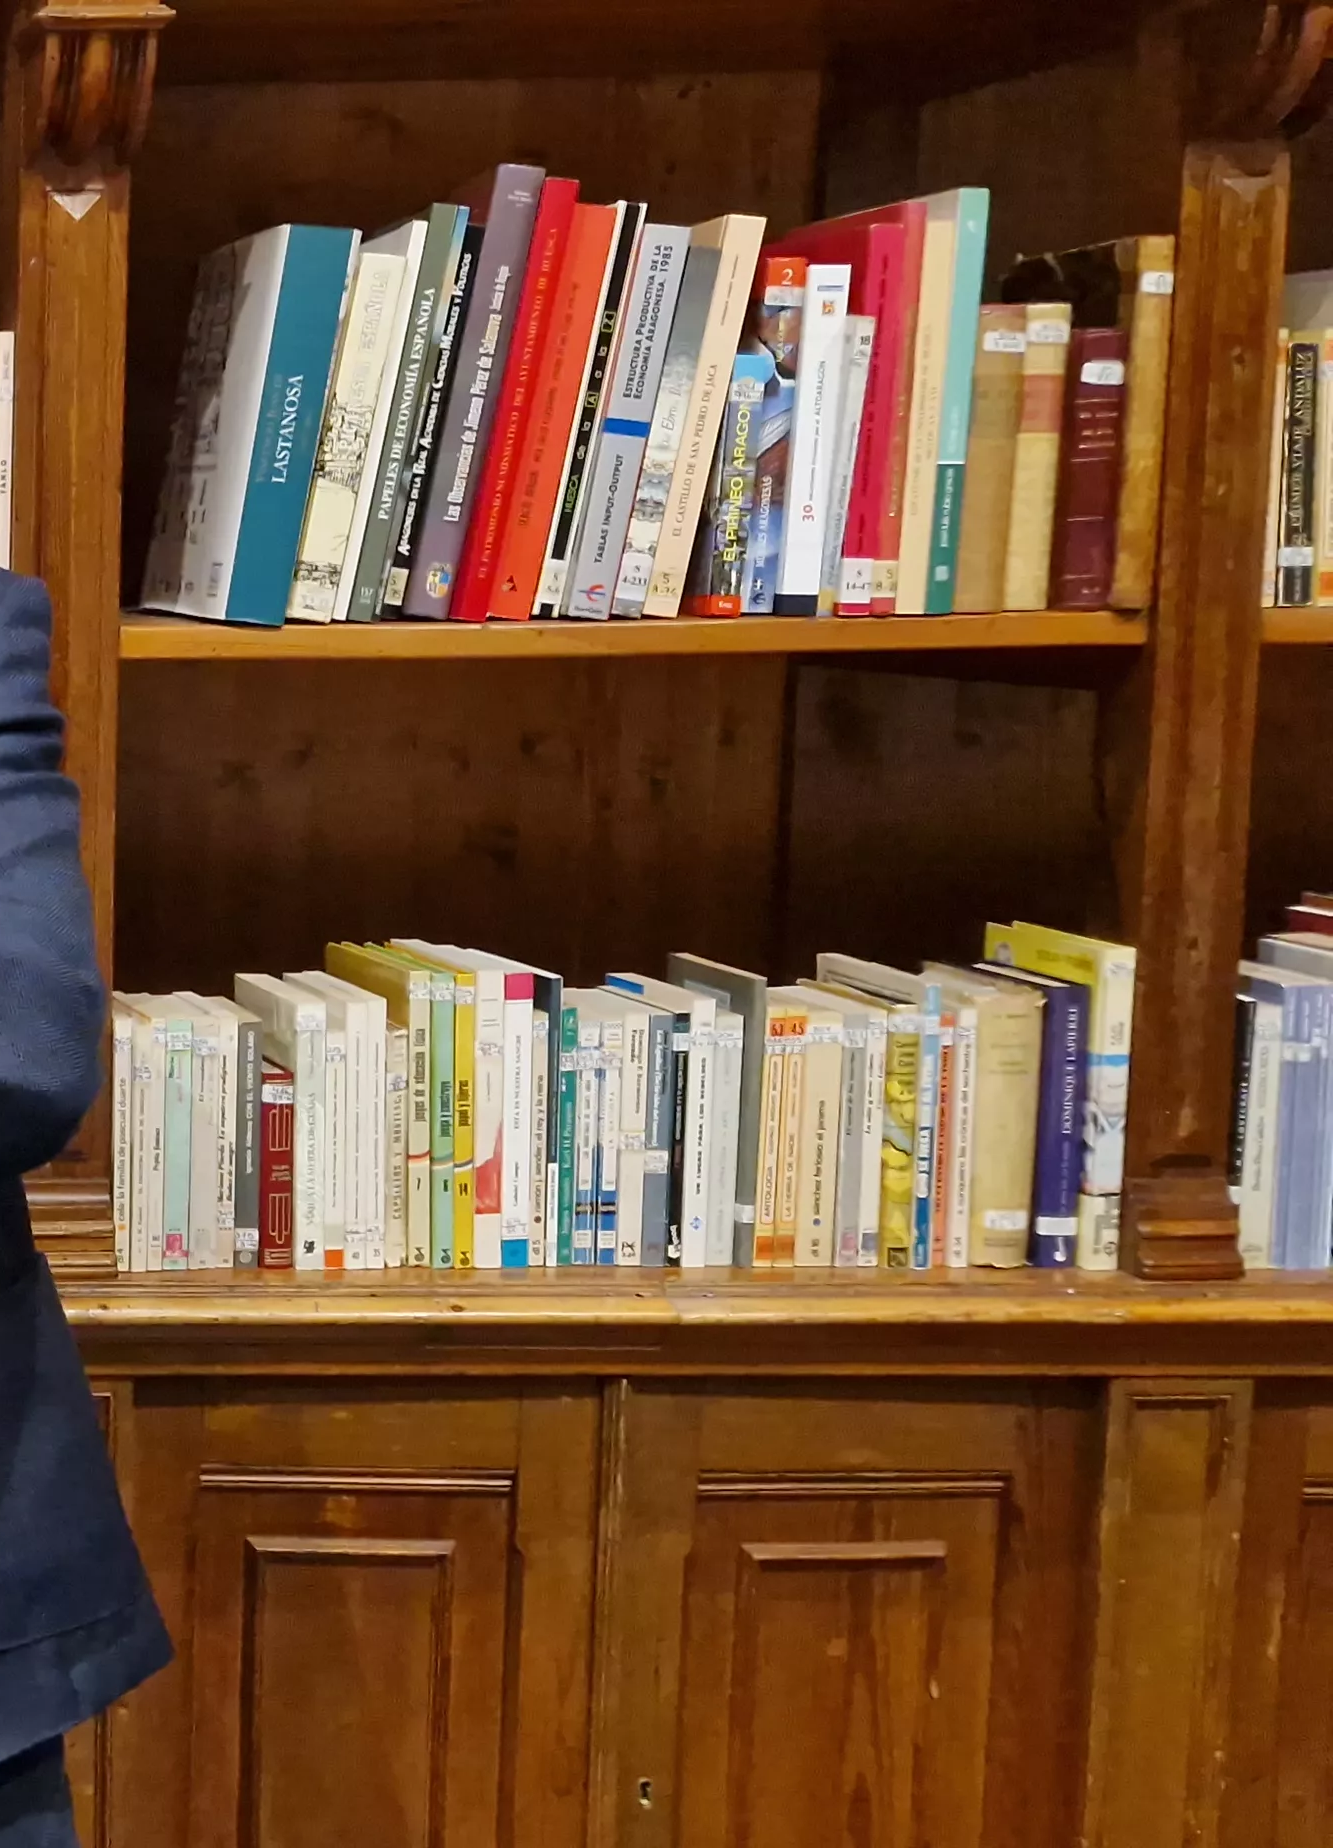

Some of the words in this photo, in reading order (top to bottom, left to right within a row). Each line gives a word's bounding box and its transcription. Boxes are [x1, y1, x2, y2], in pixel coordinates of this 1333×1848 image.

[652, 244, 662, 257] LA
[647, 258, 659, 272] DE
[781, 269, 793, 285] 2
[635, 275, 659, 336] PRODUCTIVA
[411, 288, 435, 360] ESPAÑOLA
[477, 356, 493, 368] de
[598, 345, 608, 356] la
[622, 338, 644, 398] ESTRUCTURA
[705, 364, 719, 388] JACA
[470, 370, 491, 395] Pérez
[395, 362, 421, 437] ECONOMÍA
[587, 394, 597, 404] A
[701, 389, 711, 402] DE
[272, 374, 304, 483] LASTANOSA
[579, 420, 591, 431] la
[692, 405, 709, 438] PEDRO
[390, 439, 404, 459] DE
[461, 431, 476, 442] de
[576, 445, 586, 460] de
[684, 460, 696, 475] DE
[378, 461, 401, 520] PAPELES
[563, 474, 580, 513] HUESCA
[599, 453, 625, 526] INPUT-OUTPUT
[673, 478, 694, 523] CASTILLO
[443, 505, 461, 522] Las
[725, 477, 745, 540] PIRINEO
[671, 525, 683, 537] EL
[593, 529, 611, 564] TABLAS
[723, 541, 738, 562] EL
[1065, 1007, 1078, 1061] LAPIERRE
[118, 1078, 126, 1108] duarte
[1060, 1065, 1077, 1134] DOMINIQUE
[118, 1110, 127, 1145] pascual
[118, 1147, 126, 1156] de
[117, 1159, 126, 1189] familia
